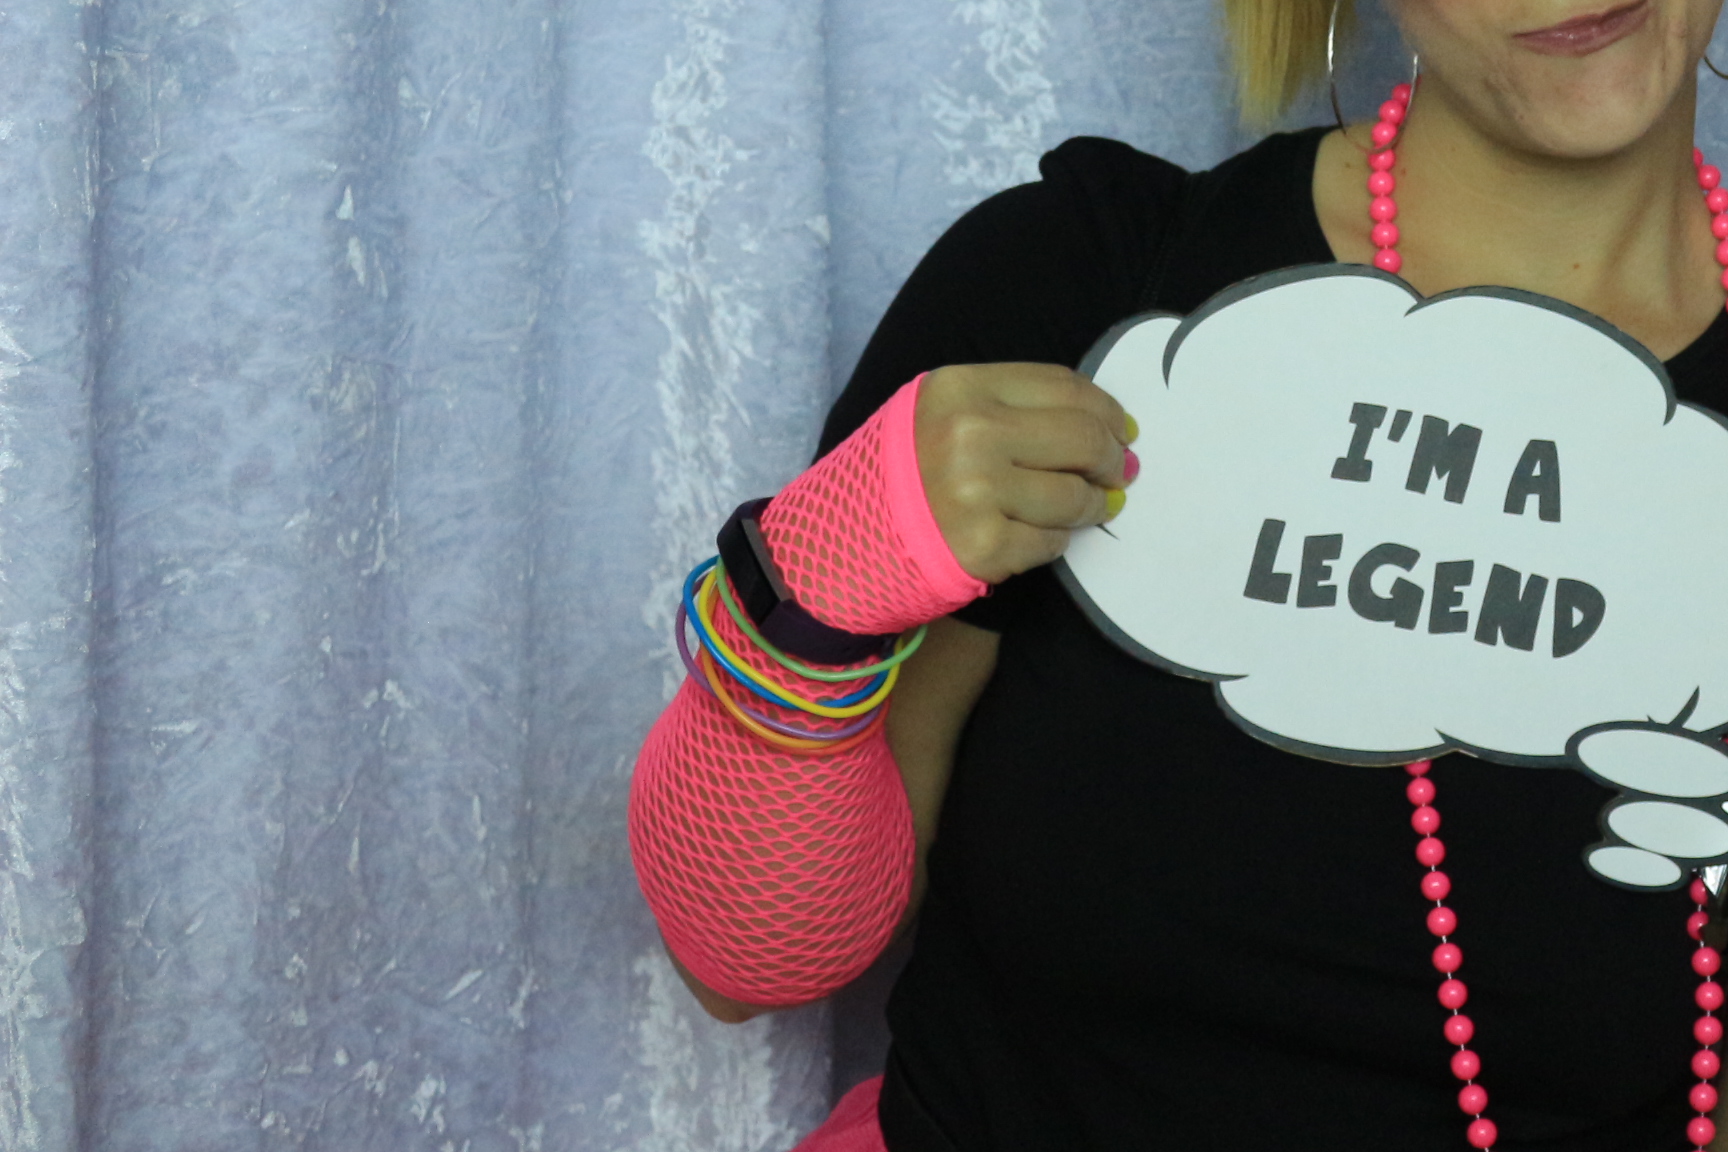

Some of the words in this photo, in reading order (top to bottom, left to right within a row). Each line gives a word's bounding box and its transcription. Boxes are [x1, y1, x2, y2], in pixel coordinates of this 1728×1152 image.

[1330, 402, 1483, 504] I'M
[1502, 439, 1561, 522] A
[1242, 518, 1606, 659] LEGEND
